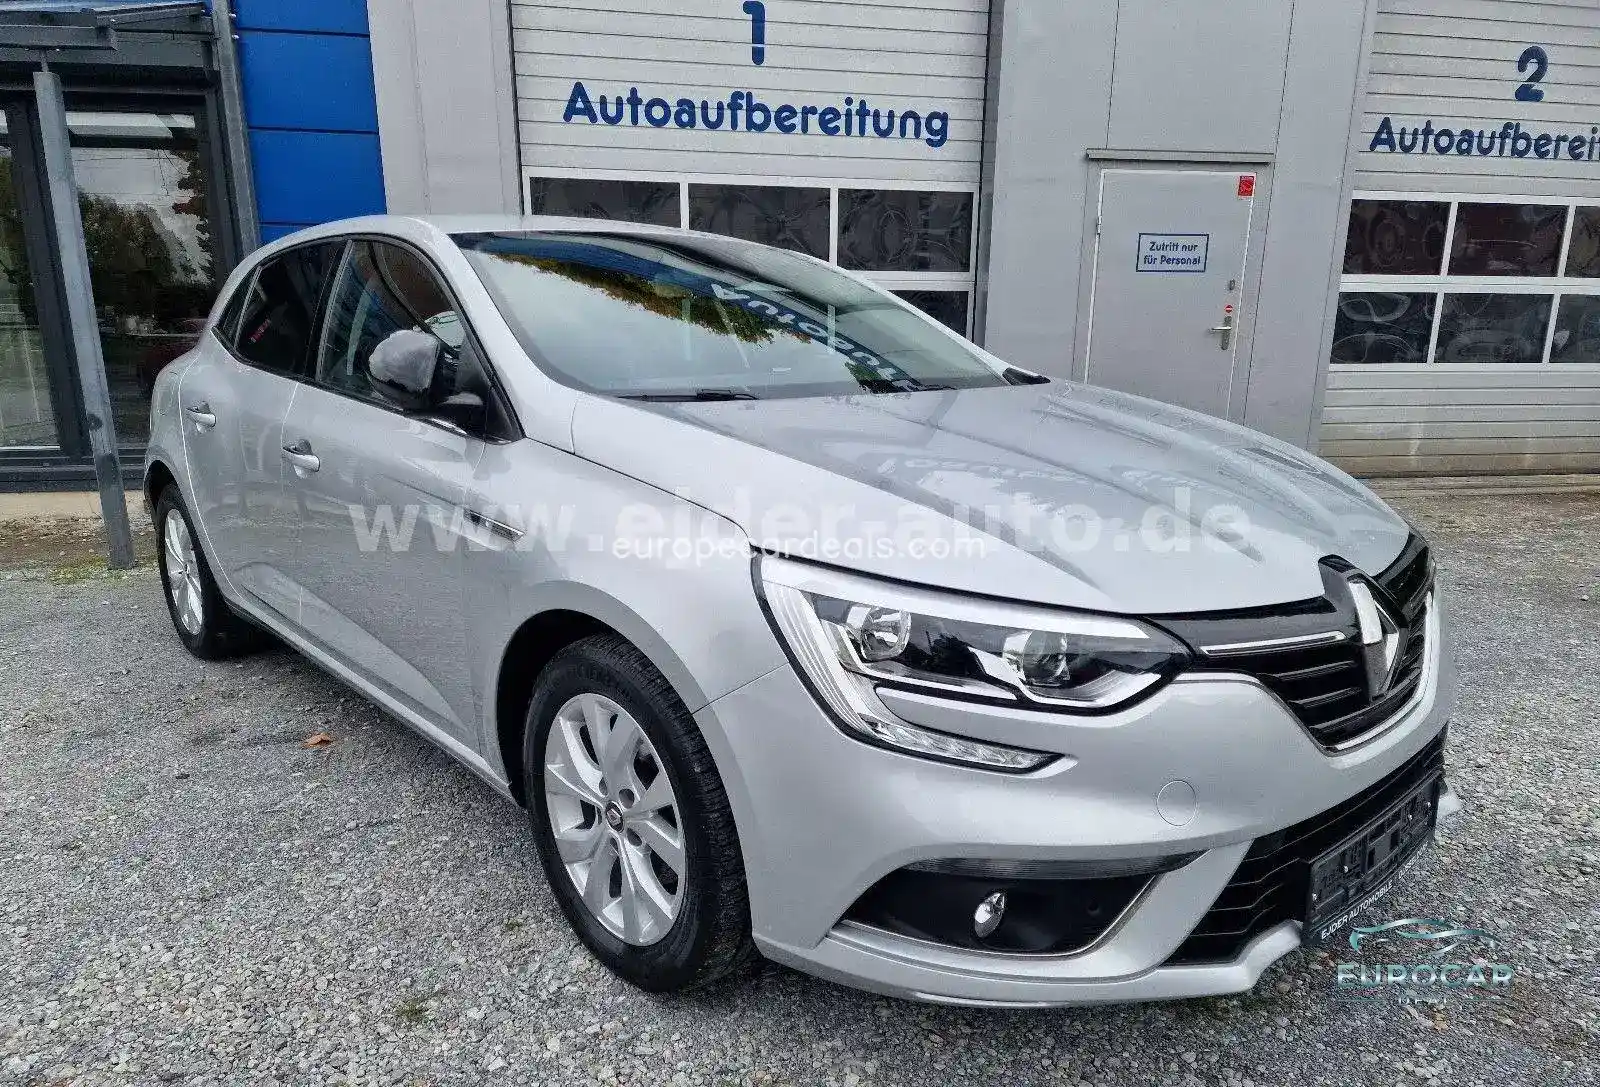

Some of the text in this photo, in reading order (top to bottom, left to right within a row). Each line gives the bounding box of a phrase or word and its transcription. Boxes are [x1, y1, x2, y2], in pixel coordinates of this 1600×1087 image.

[743, 0, 766, 66] 1
[1515, 45, 1548, 102] 2
[562, 81, 949, 148] Autoaufbereitung
[1369, 116, 1600, 161] Autoaufberei
[1143, 255, 1200, 265] für Personal
[1149, 241, 1199, 252] Zutritt nur
[1321, 879, 1394, 940] EJDER AUTOMOBILE
